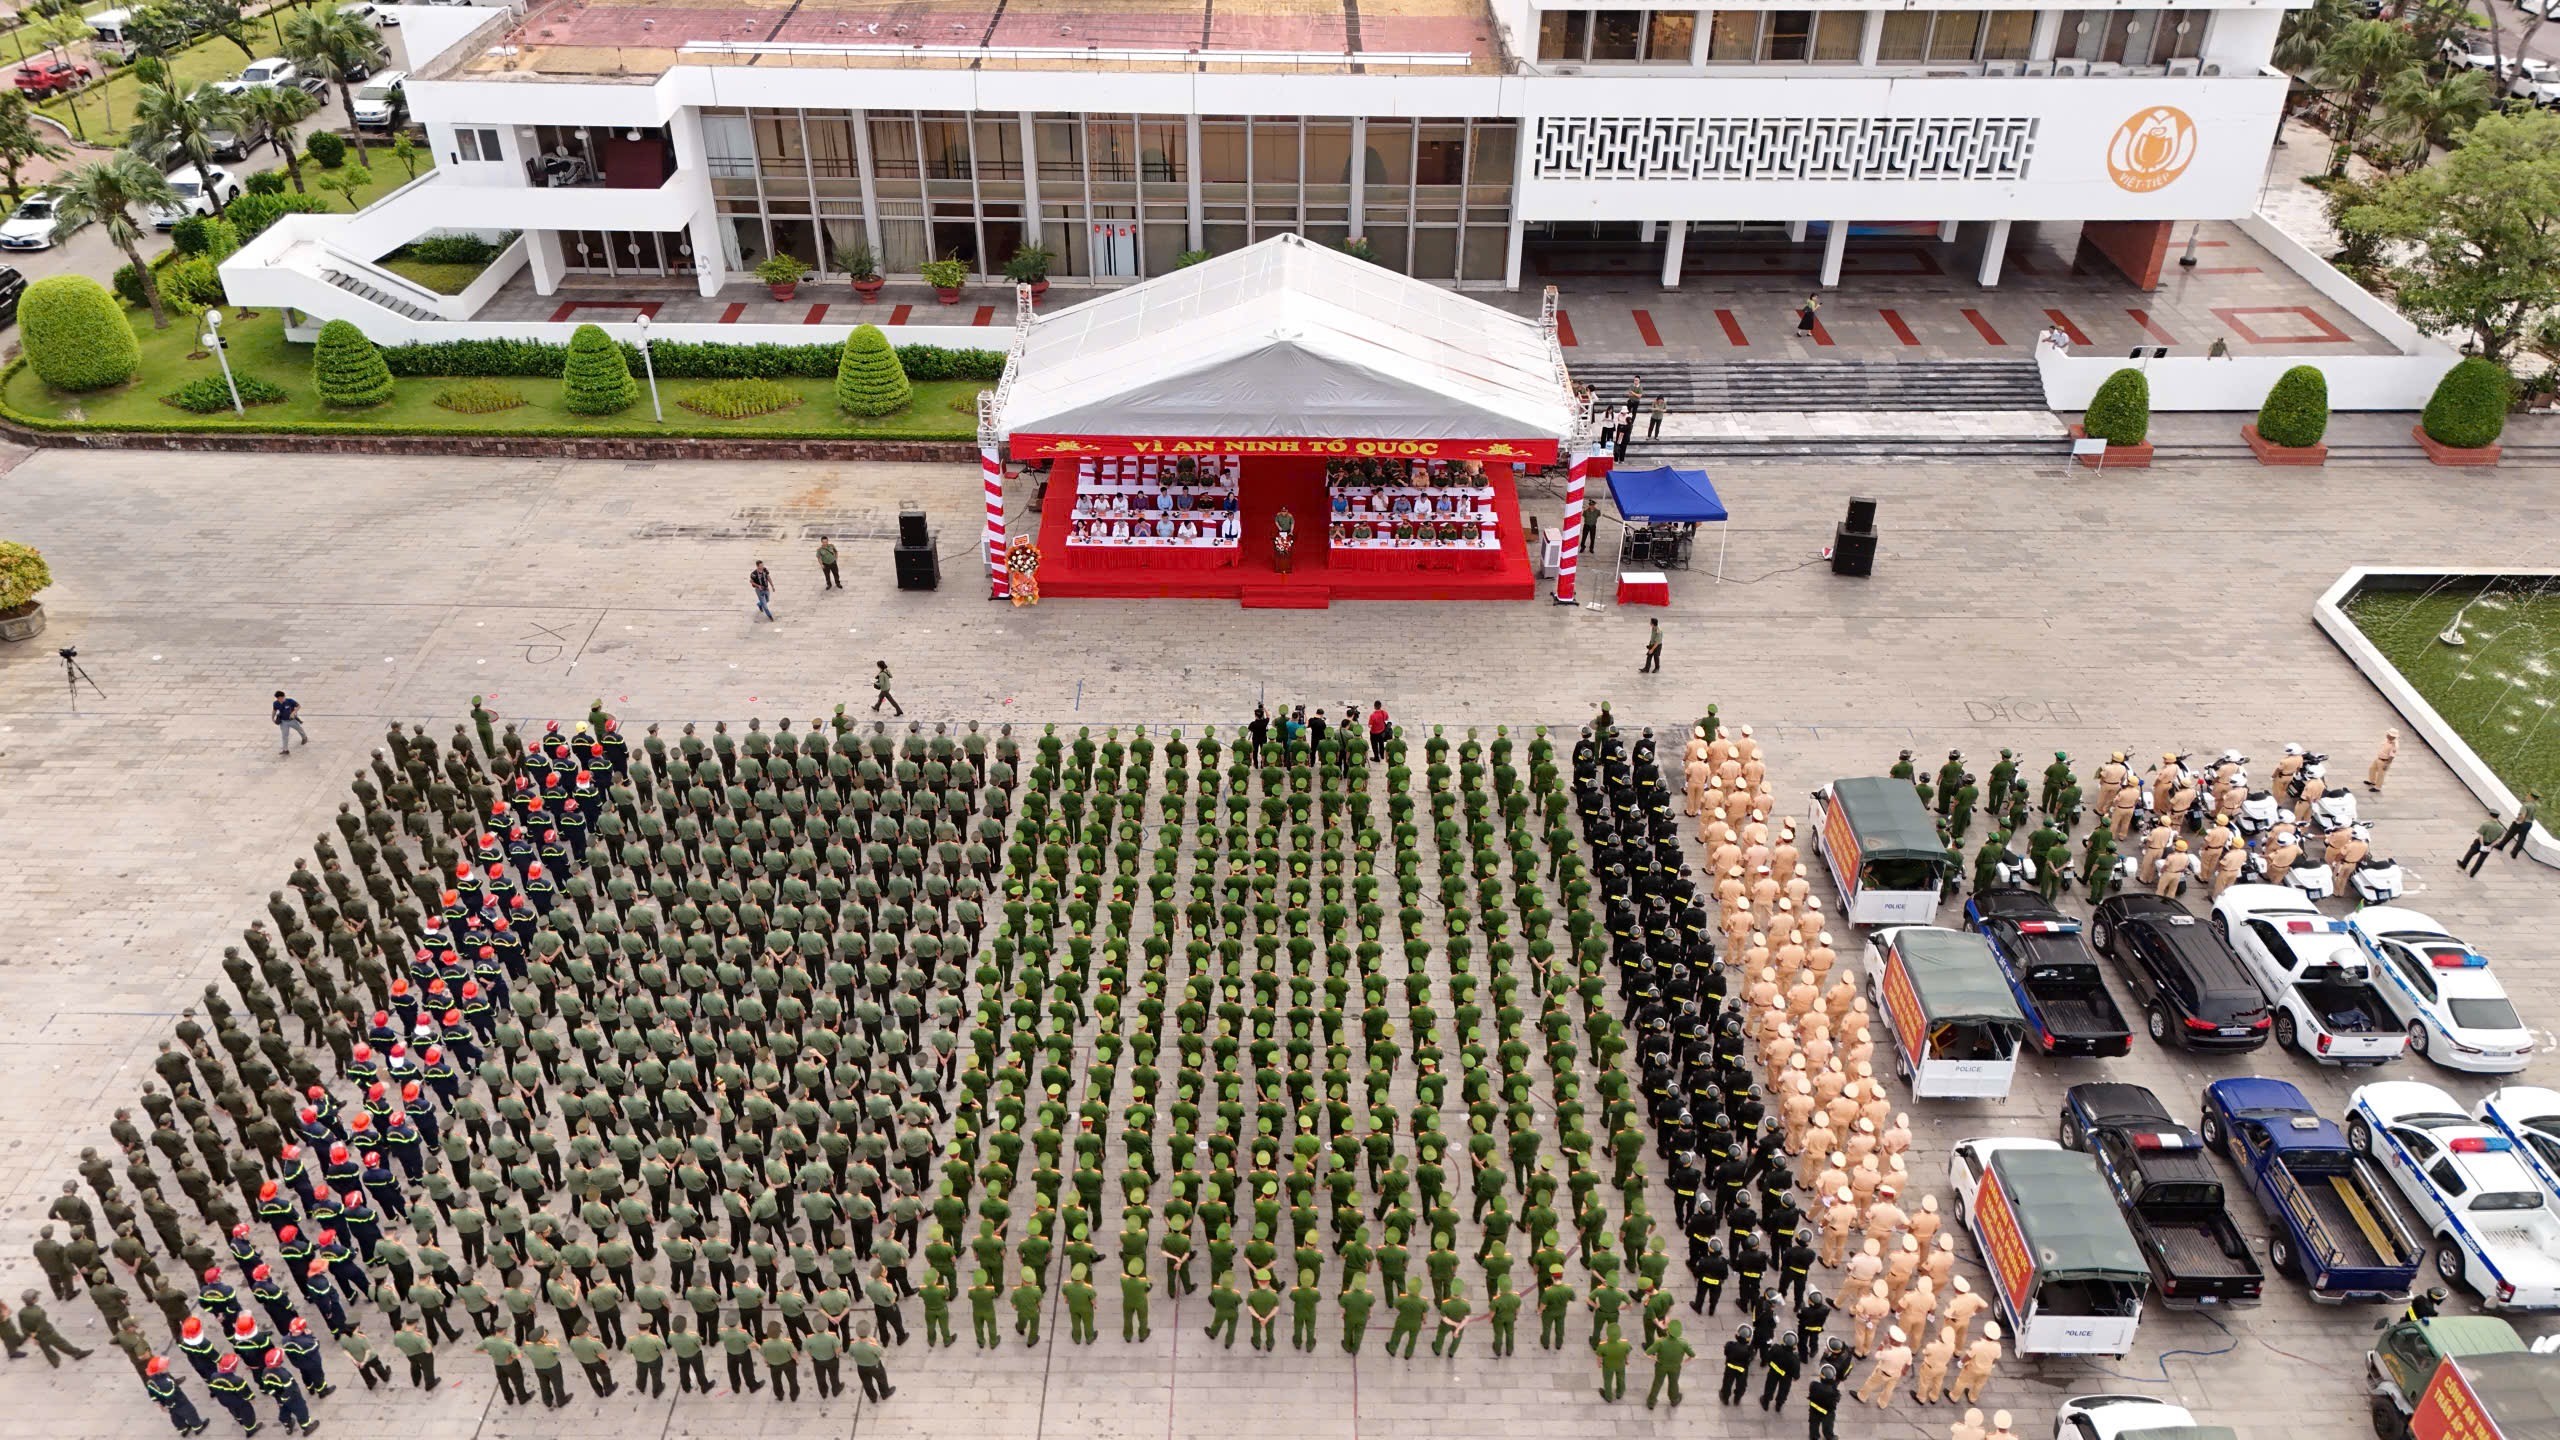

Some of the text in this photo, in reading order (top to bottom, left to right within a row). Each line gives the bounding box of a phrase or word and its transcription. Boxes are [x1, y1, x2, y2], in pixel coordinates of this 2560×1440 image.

[1132, 438, 1439, 456] VÌ AN NINH TỔ QUỐC
[2421, 1180, 2435, 1196] GIAO
[2461, 1231, 2481, 1254] THÔNG
[2434, 1386, 2454, 1420] TRẤN
[2450, 1415, 2464, 1432] ÁP
[2444, 1376, 2466, 1409] CÔNG
[2462, 1405, 2478, 1426] AN
